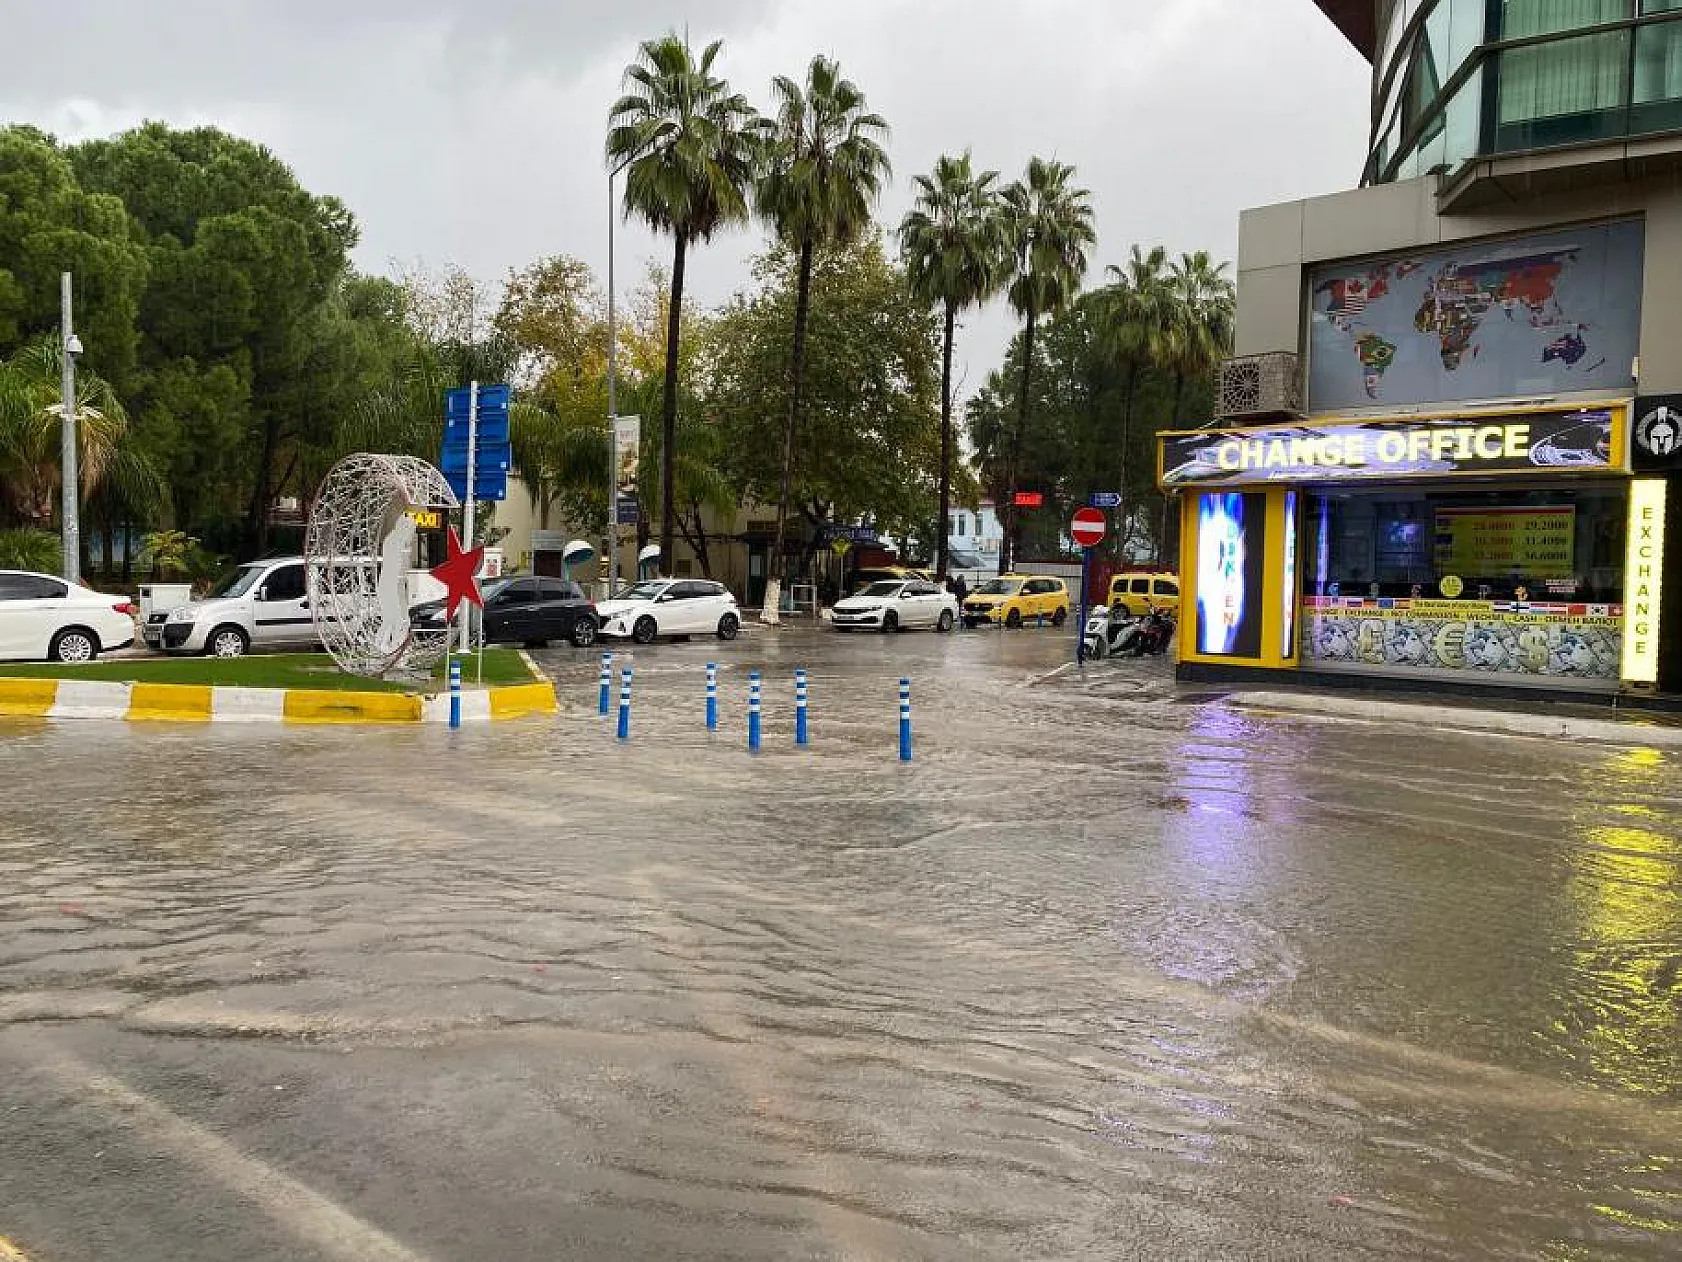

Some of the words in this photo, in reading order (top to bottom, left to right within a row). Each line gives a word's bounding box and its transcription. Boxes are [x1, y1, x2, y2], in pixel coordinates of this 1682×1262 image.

[1218, 435, 1367, 470] CHANGE
[1376, 424, 1530, 463] OFFICE
[1635, 507, 1654, 654] EXCHANGE
